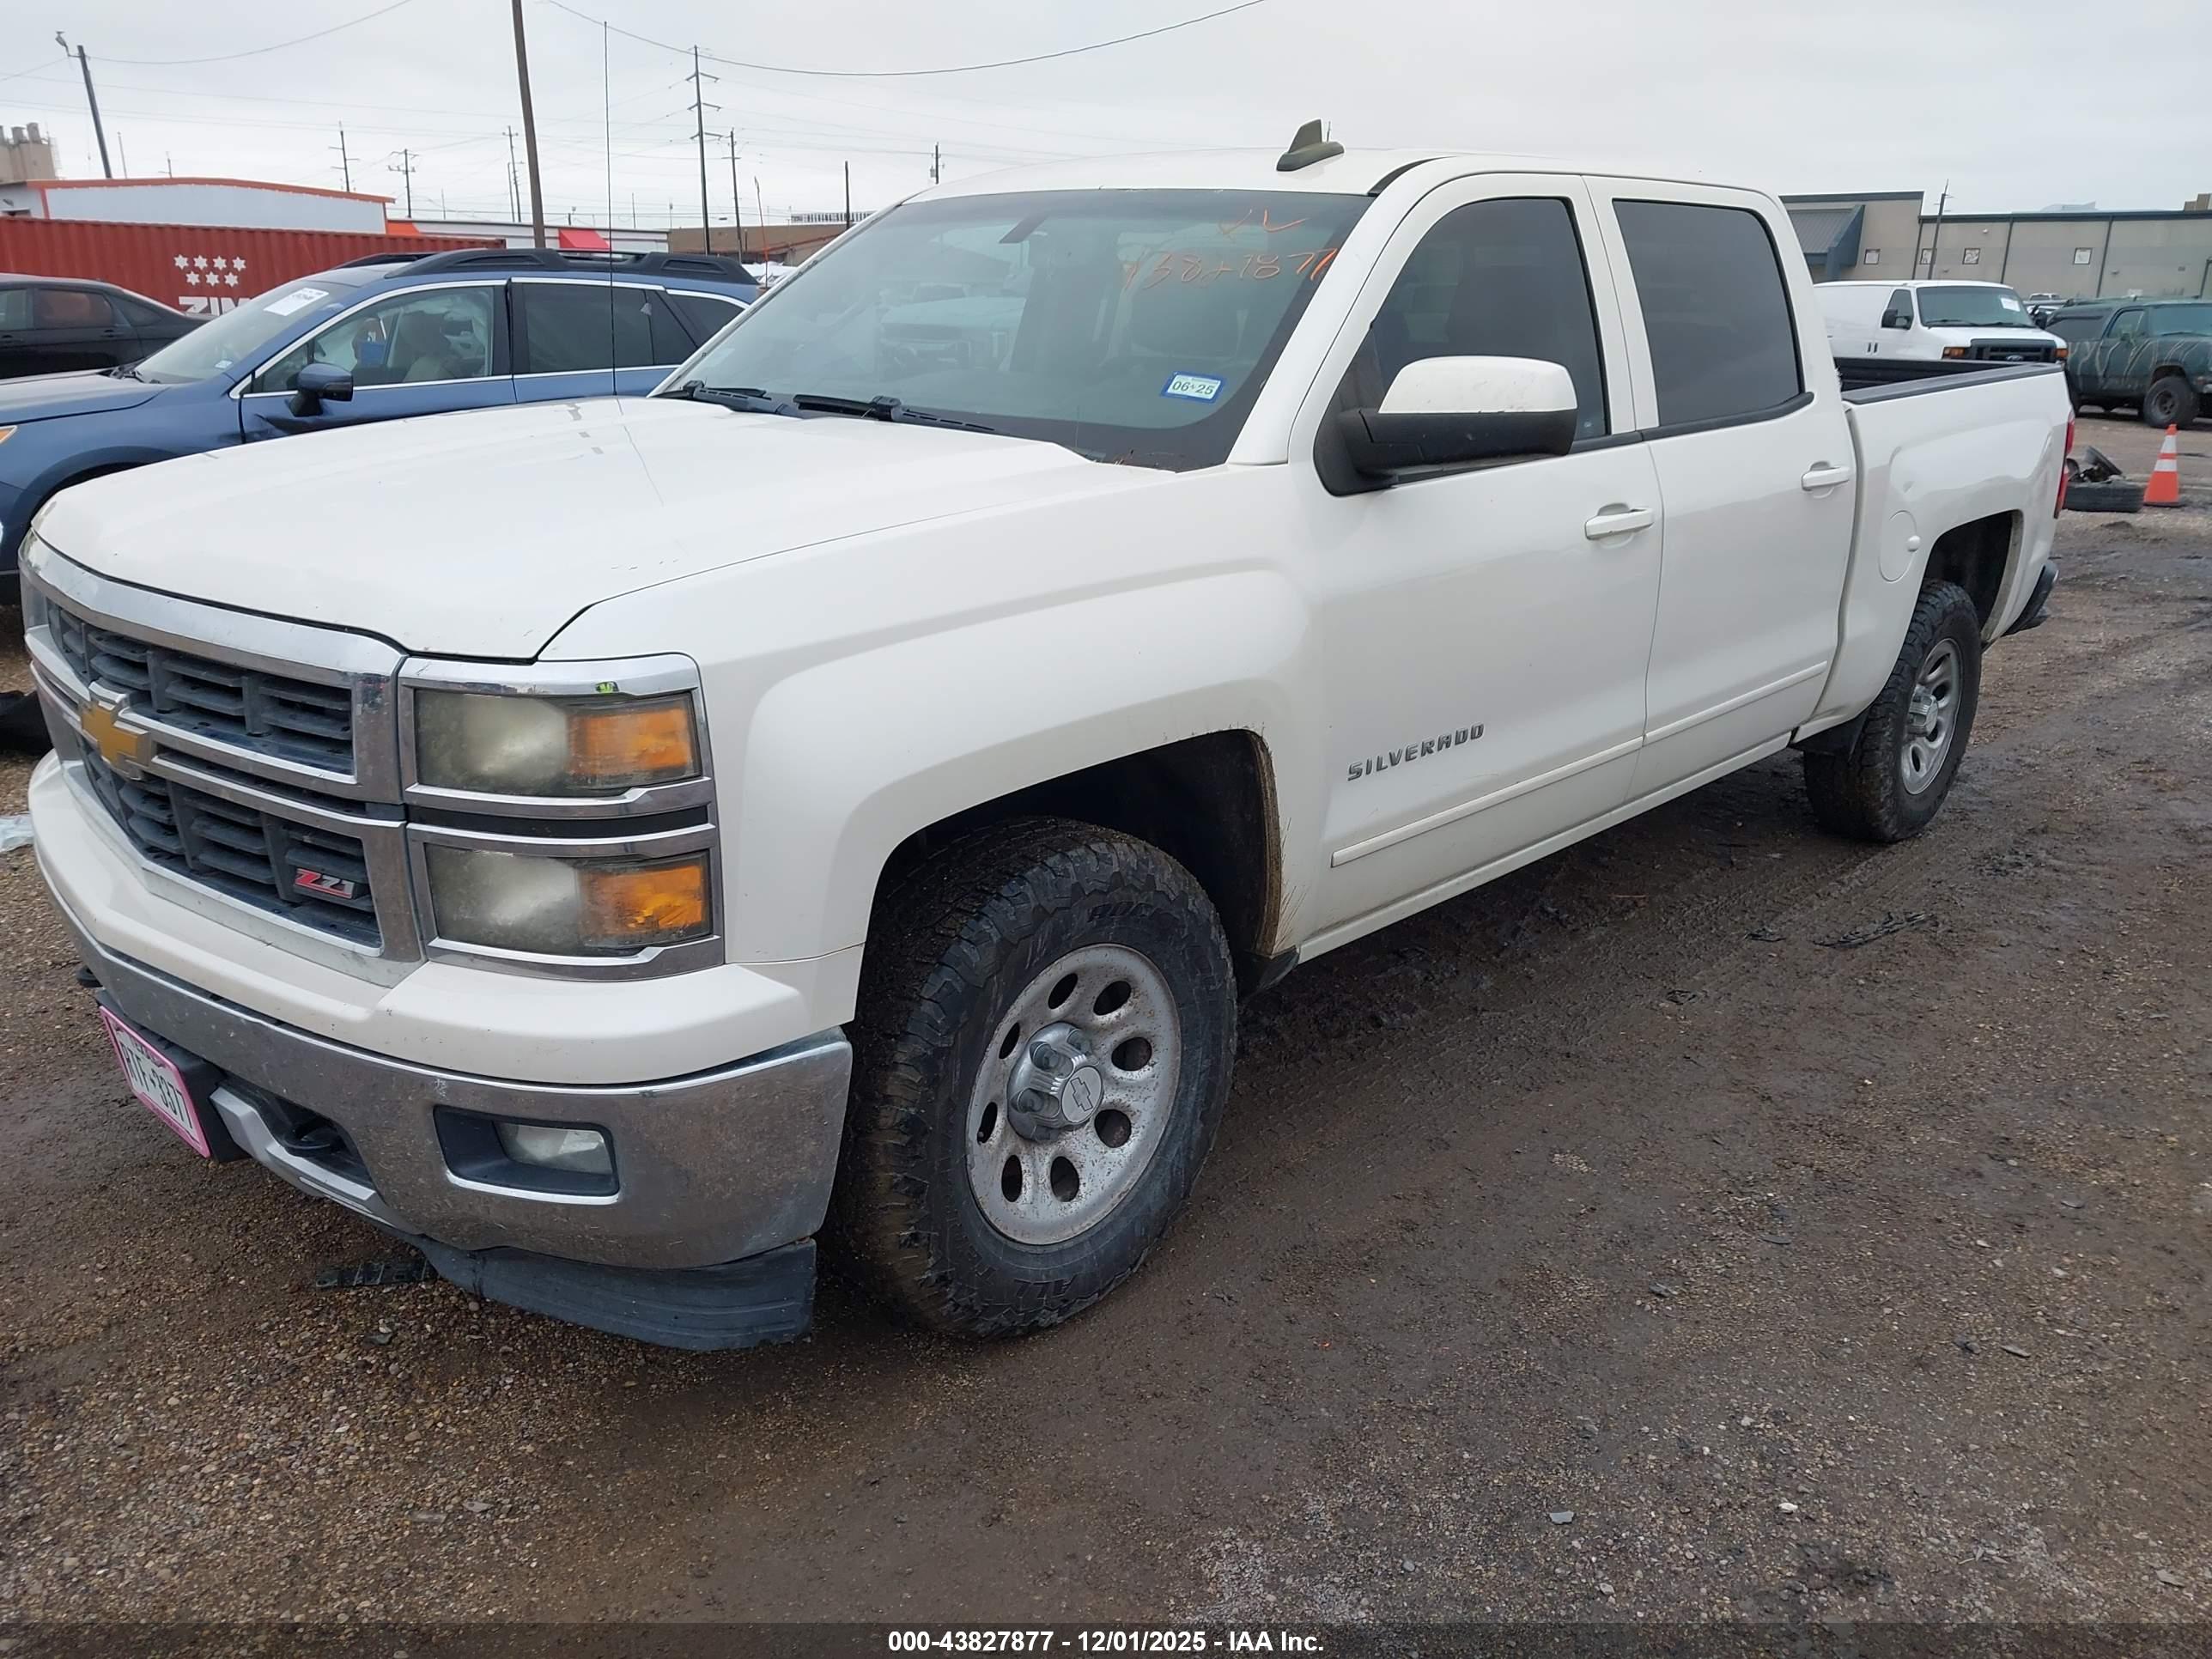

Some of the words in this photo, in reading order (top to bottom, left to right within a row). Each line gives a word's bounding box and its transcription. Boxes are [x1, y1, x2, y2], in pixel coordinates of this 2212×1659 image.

[1171, 380, 1191, 392] 06
[1194, 383, 1216, 395] 25
[1347, 723, 1485, 782] SILVERADO
[295, 867, 355, 899] Z71
